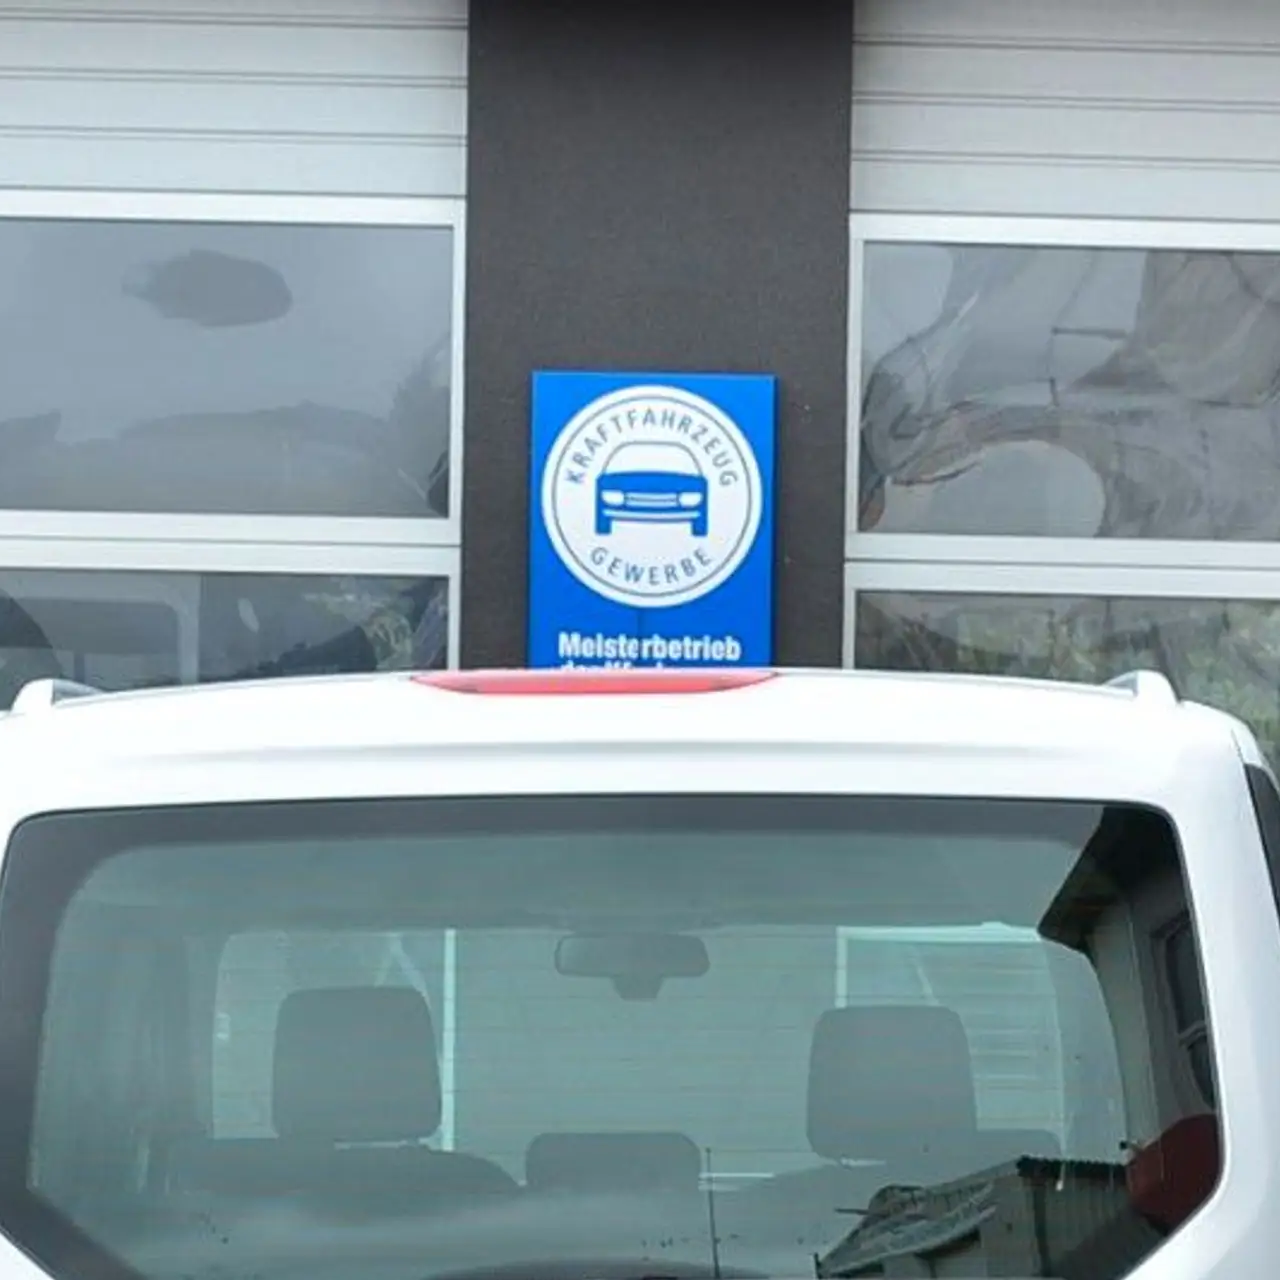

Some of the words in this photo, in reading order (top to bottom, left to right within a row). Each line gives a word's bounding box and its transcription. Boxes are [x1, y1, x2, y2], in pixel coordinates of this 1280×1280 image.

[564, 407, 738, 486] KRAFTFAHRZEUG
[590, 545, 713, 586] GEWERBE
[558, 631, 742, 661] Meisterbetrieb
